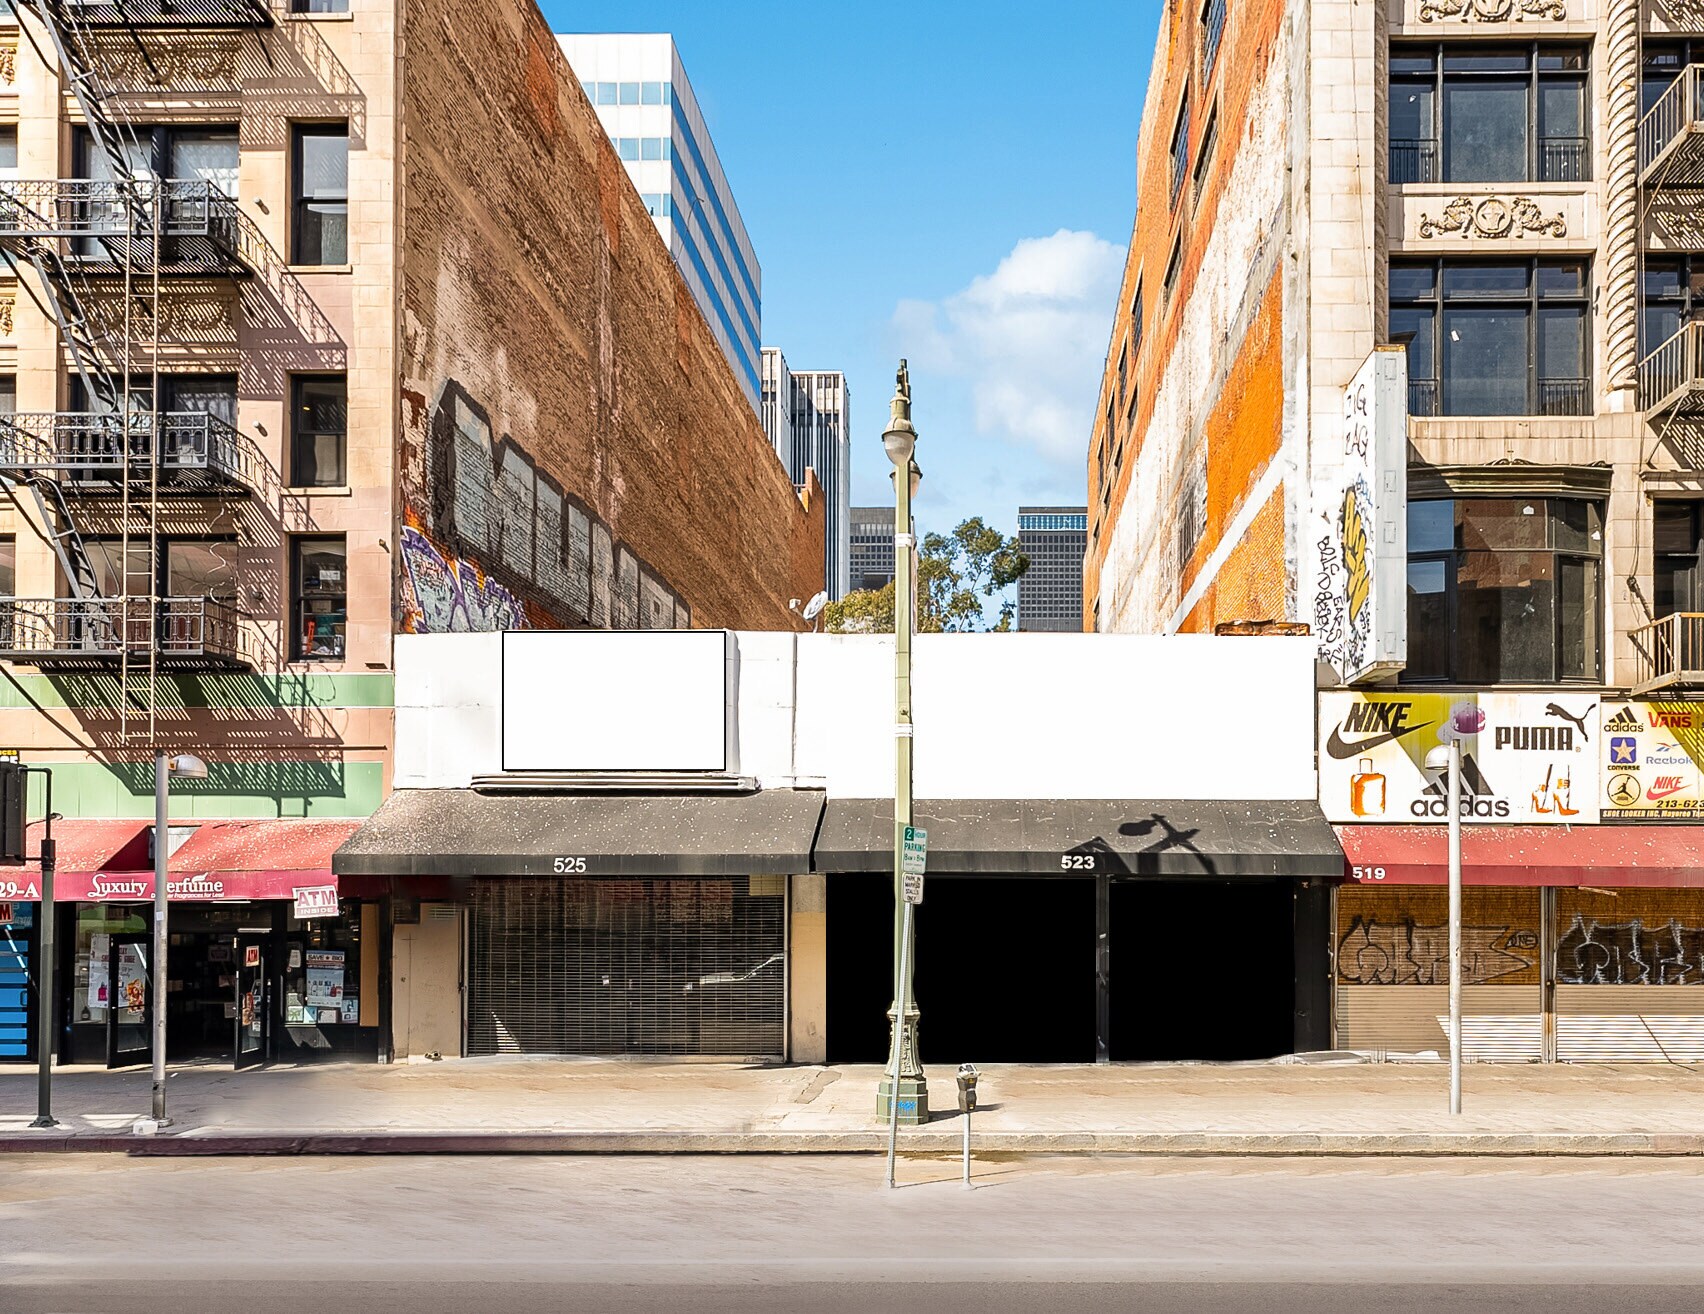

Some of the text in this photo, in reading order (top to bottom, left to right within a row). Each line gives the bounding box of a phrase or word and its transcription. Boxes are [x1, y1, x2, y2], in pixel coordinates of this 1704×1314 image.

[1343, 702, 1413, 733] NIKE
[1648, 711, 1692, 728] VANS
[1603, 723, 1644, 733] adidas
[1495, 726, 1573, 751] PUMA
[1646, 756, 1693, 764] Reebok
[1653, 776, 1684, 790] NIKE
[1410, 795, 1510, 817] addas
[906, 829, 912, 840] 2
[904, 843, 925, 852] PARKING
[553, 856, 587, 873] 525
[1060, 854, 1096, 870] 523
[1352, 866, 1386, 880] 519
[87, 873, 224, 898] Luxury erfume
[297, 889, 336, 907] ATM
[300, 906, 334, 915] INSIDE
